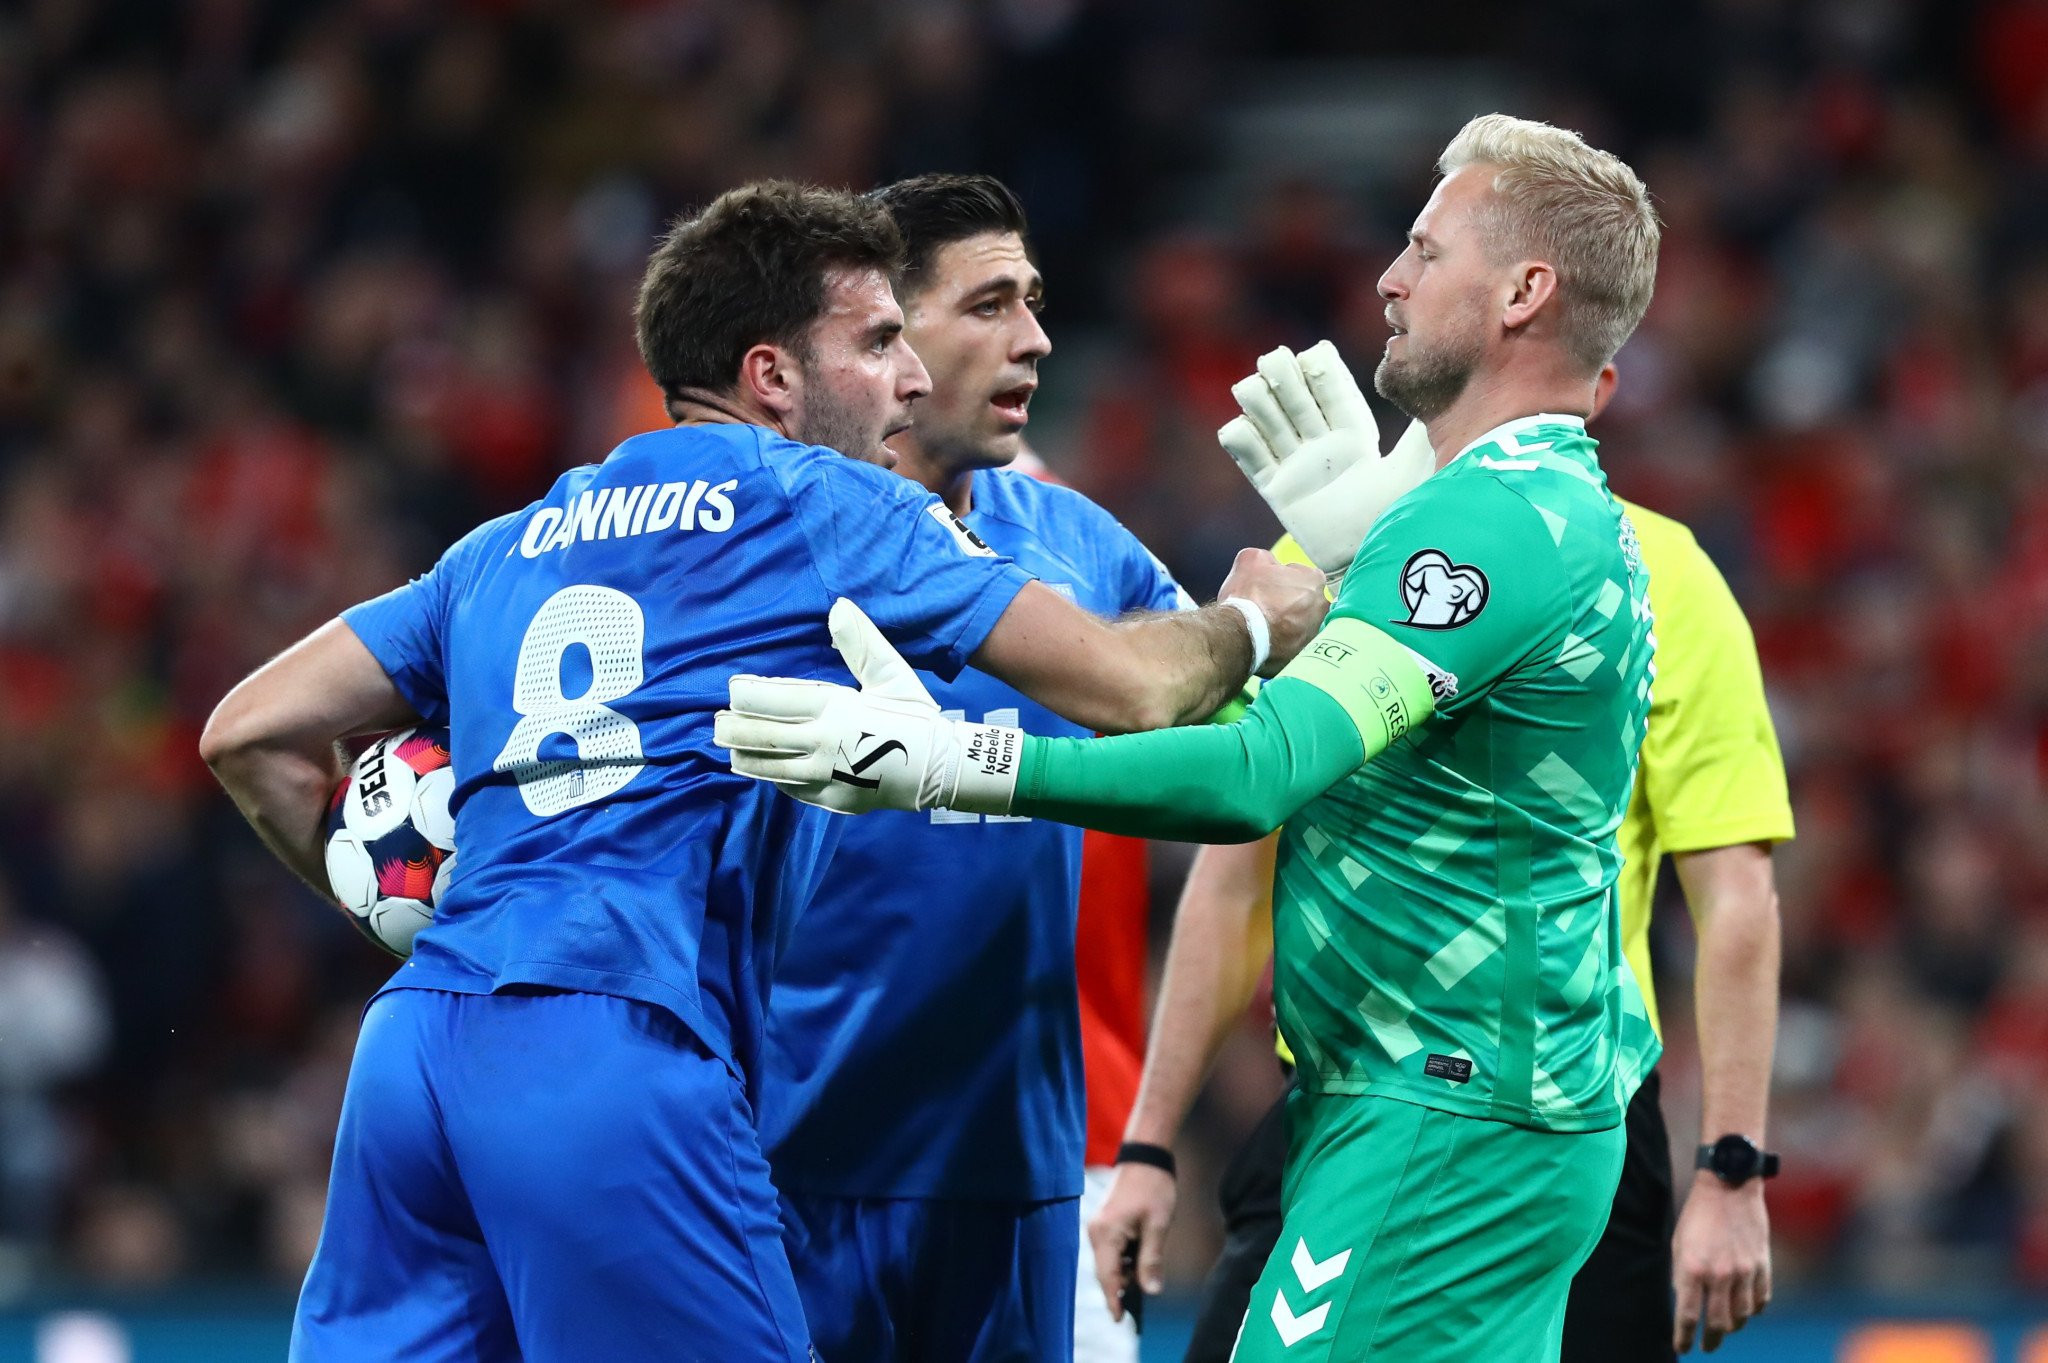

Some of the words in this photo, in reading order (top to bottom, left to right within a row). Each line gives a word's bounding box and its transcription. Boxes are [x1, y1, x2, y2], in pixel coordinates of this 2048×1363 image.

[507, 479, 739, 560] OANNIDIS
[493, 583, 646, 818] 8
[967, 732, 983, 761] Max
[981, 728, 1000, 775] Isabella
[996, 733, 1015, 775] Nanna
